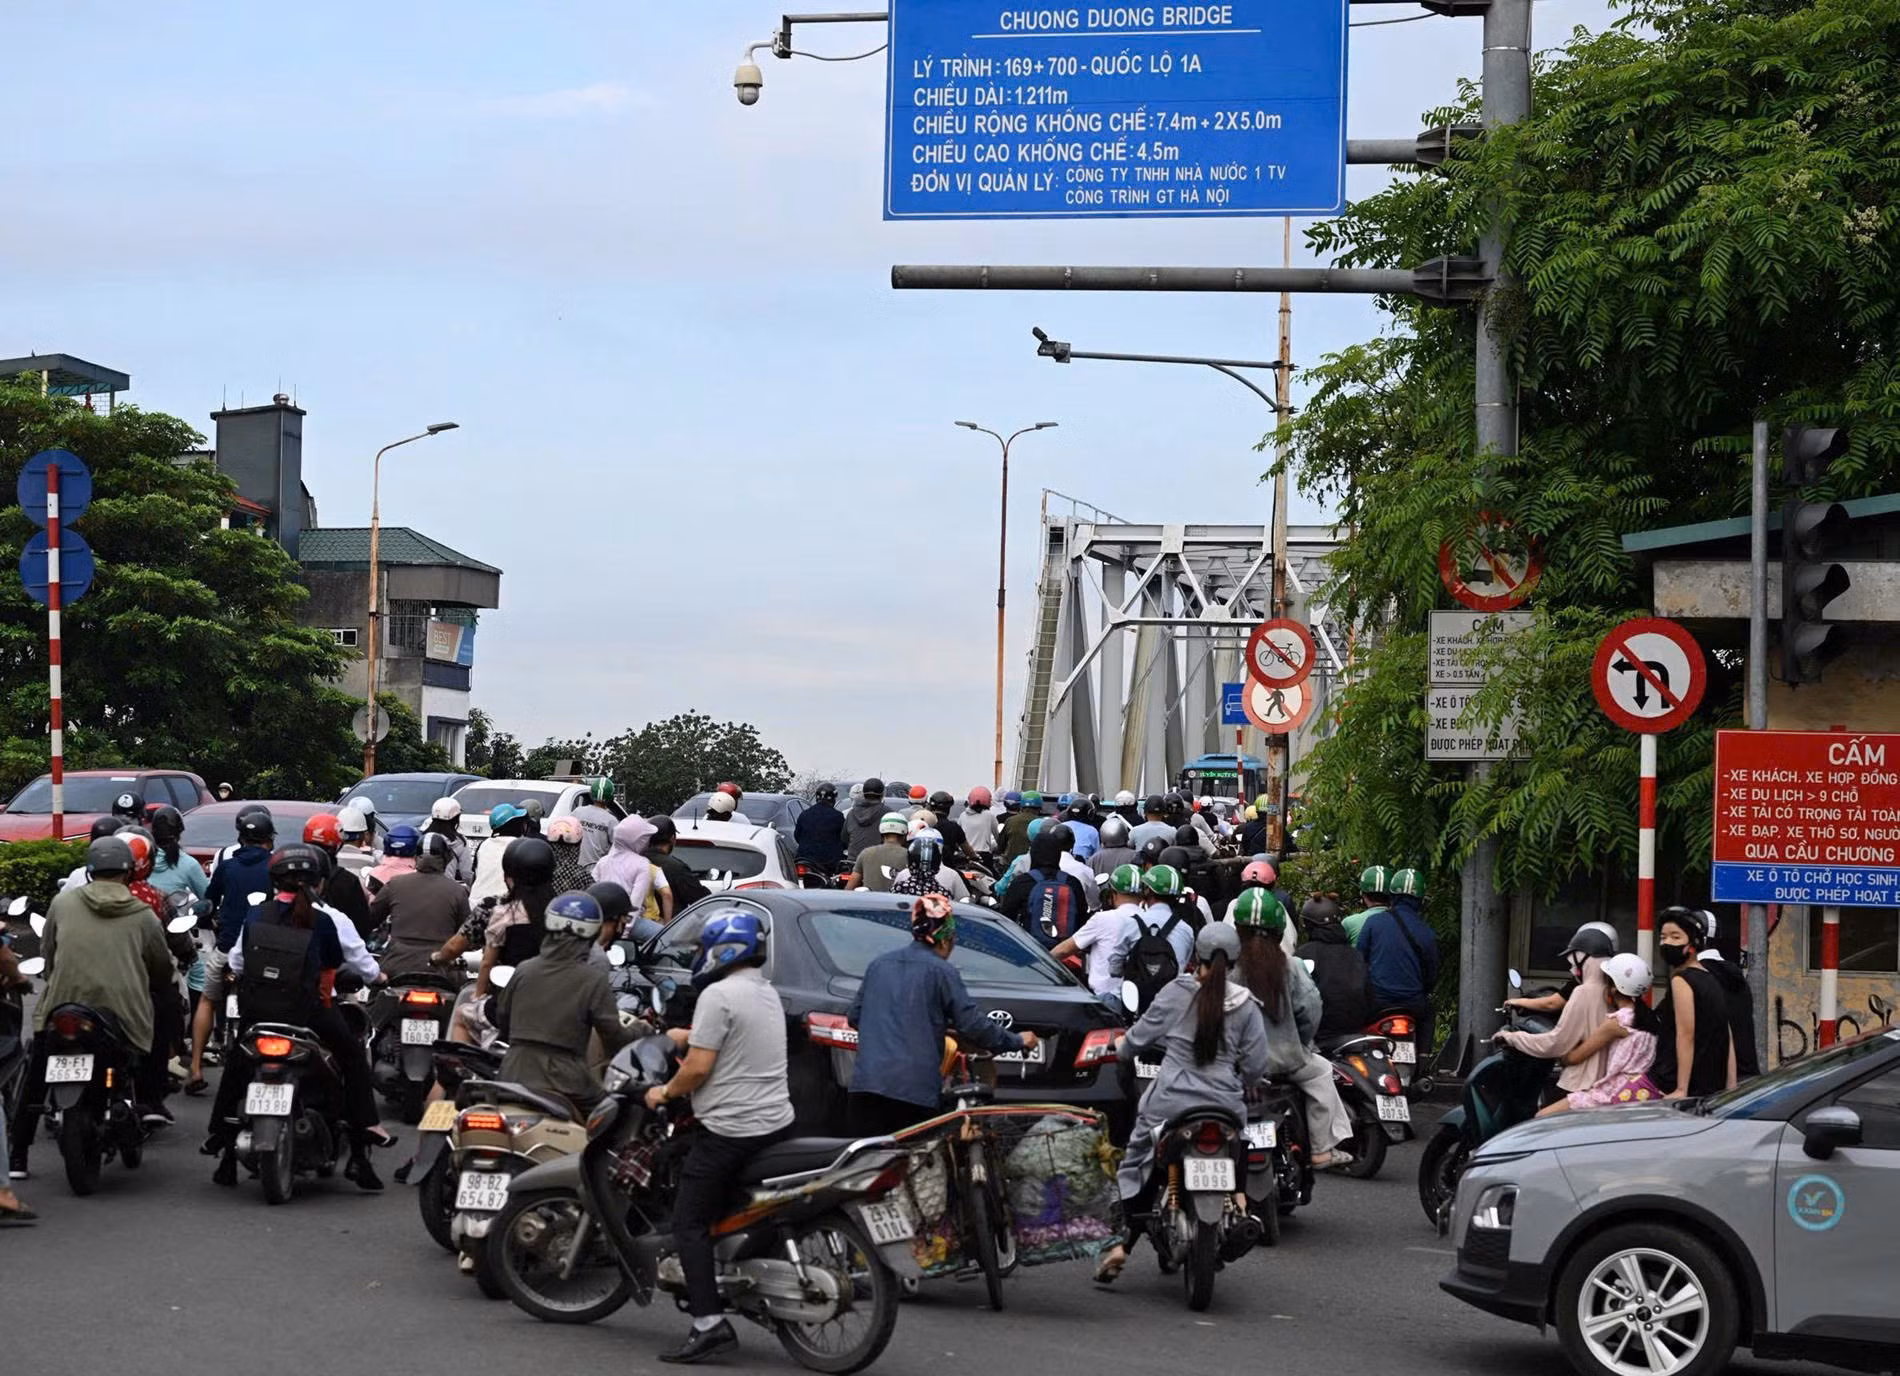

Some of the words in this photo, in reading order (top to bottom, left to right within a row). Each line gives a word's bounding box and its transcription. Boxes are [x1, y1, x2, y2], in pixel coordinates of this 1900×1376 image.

[1000, 10, 1079, 30] CHUONG
[1088, 8, 1154, 28] DUONG
[1162, 5, 1233, 26] BRIDGE
[914, 55, 933, 78] LÝ
[1091, 48, 1142, 76] QUỐC
[1150, 50, 1172, 77] LỘ
[1180, 54, 1202, 73] 1A
[914, 81, 967, 106] CHIỀU
[913, 108, 967, 134] CHIỀU
[974, 110, 1028, 137] RỘNG
[1036, 106, 1102, 133] KHỐNG
[912, 138, 966, 163] CHIỀU
[974, 143, 1010, 162] CAO
[1018, 135, 1083, 162] KHỐNG
[911, 169, 950, 192] ĐƠN
[956, 172, 973, 195] VỊ
[979, 168, 1028, 192] QUẢN
[1066, 165, 1104, 182] CÔNG
[1111, 167, 1128, 182] TY
[1135, 167, 1170, 182] TNHH
[1175, 162, 1204, 181] NHÀ
[1210, 161, 1248, 181] NƯỚC
[1255, 166, 1260, 180] 1
[1268, 165, 1287, 180] TV
[1066, 186, 1104, 205] CÔNG
[1111, 185, 1150, 204] TRÌNH
[1156, 189, 1175, 204] GT
[1181, 185, 1200, 204] HÀ
[1206, 185, 1229, 206] NỘI
[433, 630, 452, 645] BEST
[1436, 670, 1445, 679] XE
[1450, 694, 1457, 708] Ô
[1431, 738, 1456, 752] ĐƯỢC
[1459, 736, 1483, 750] PHÉP
[1828, 736, 1886, 767] CẤM
[1723, 769, 1748, 782] -XE
[1806, 771, 1824, 783] XE
[1828, 771, 1855, 787] HỢP
[1722, 788, 1747, 800] -XE
[1752, 789, 1770, 801] DU
[1774, 789, 1803, 803] LỊCH
[1807, 792, 1816, 801] >
[1819, 791, 1827, 802] 9
[1831, 786, 1859, 803] CHỖ
[1722, 806, 1747, 818] -XE
[1752, 802, 1771, 819] TẢI
[1775, 804, 1793, 819] CÓ
[1798, 807, 1842, 823] TRỌNG
[1846, 805, 1866, 822] TẢI
[1721, 824, 1746, 836] -XE
[1786, 826, 1804, 838] XE
[1809, 824, 1835, 839] THÔ
[1745, 843, 1779, 860] QUA
[1785, 840, 1819, 860] CẦU
[1825, 844, 1895, 863] CHƯƠNG
[1747, 870, 1764, 882] XE
[1769, 867, 1778, 882] Ô
[1783, 868, 1800, 883] TÔ
[1804, 867, 1833, 884] CHỞ
[1836, 873, 1863, 887] HỌC
[1867, 873, 1898, 887] SINH
[1775, 887, 1810, 903] ĐƯỢC
[1816, 885, 1850, 900] PHÉP
[1855, 890, 1888, 904] HOẠT
[54, 1056, 86, 1069] 29-F1
[1192, 1160, 1227, 1174] 30-K9
[1193, 1175, 1228, 1188] 8096
